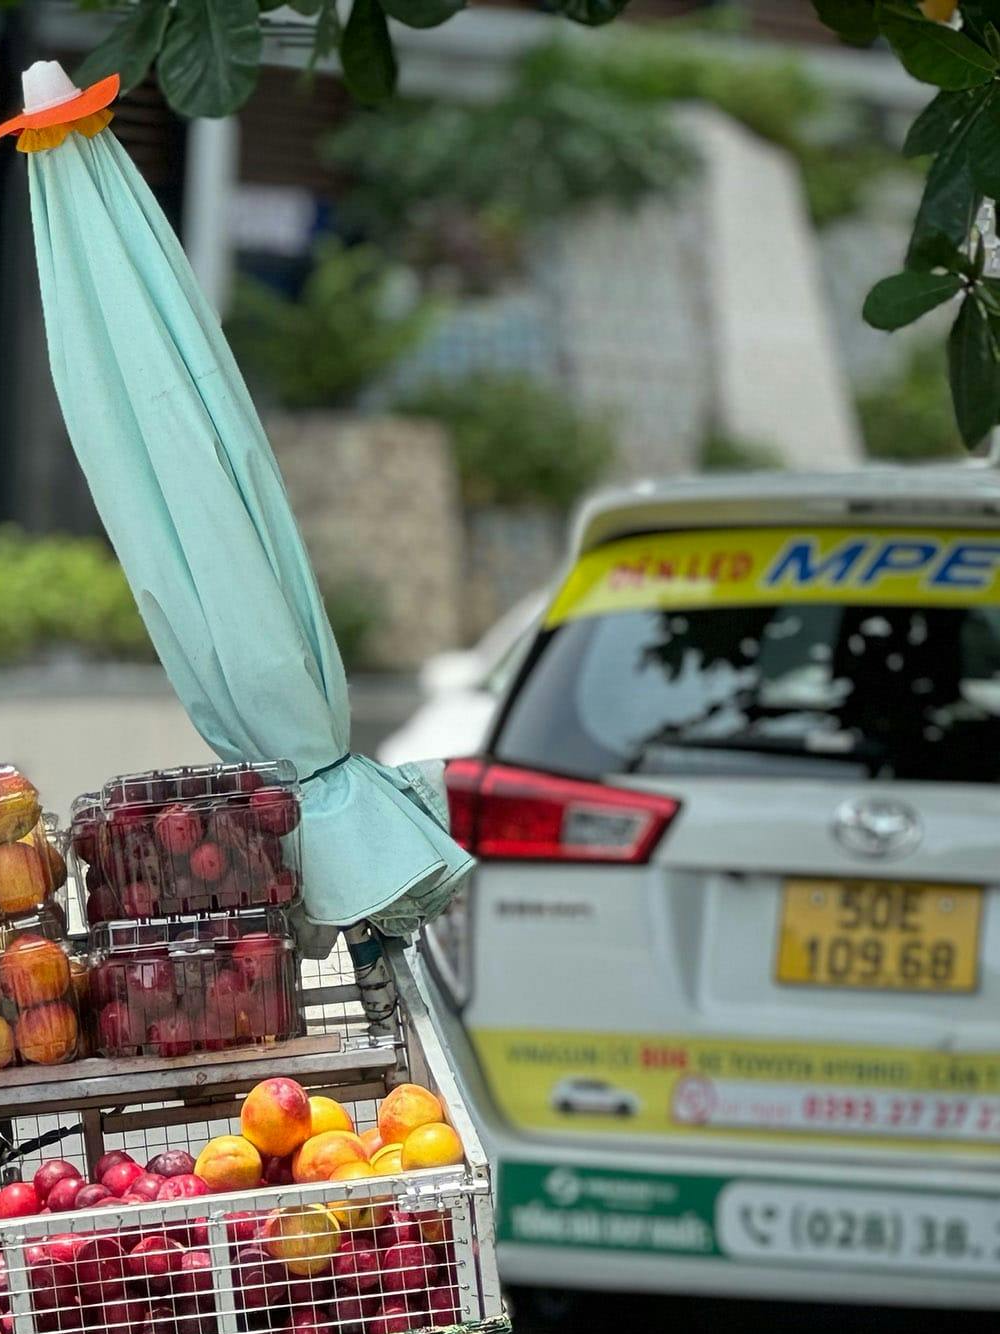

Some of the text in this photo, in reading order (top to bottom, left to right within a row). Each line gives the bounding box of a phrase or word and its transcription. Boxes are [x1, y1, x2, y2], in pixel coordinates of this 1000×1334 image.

[762, 537, 1000, 588] MPE
[840, 885, 922, 931] 50E
[808, 936, 956, 982] 109.68
[790, 1205, 903, 1254] (028)
